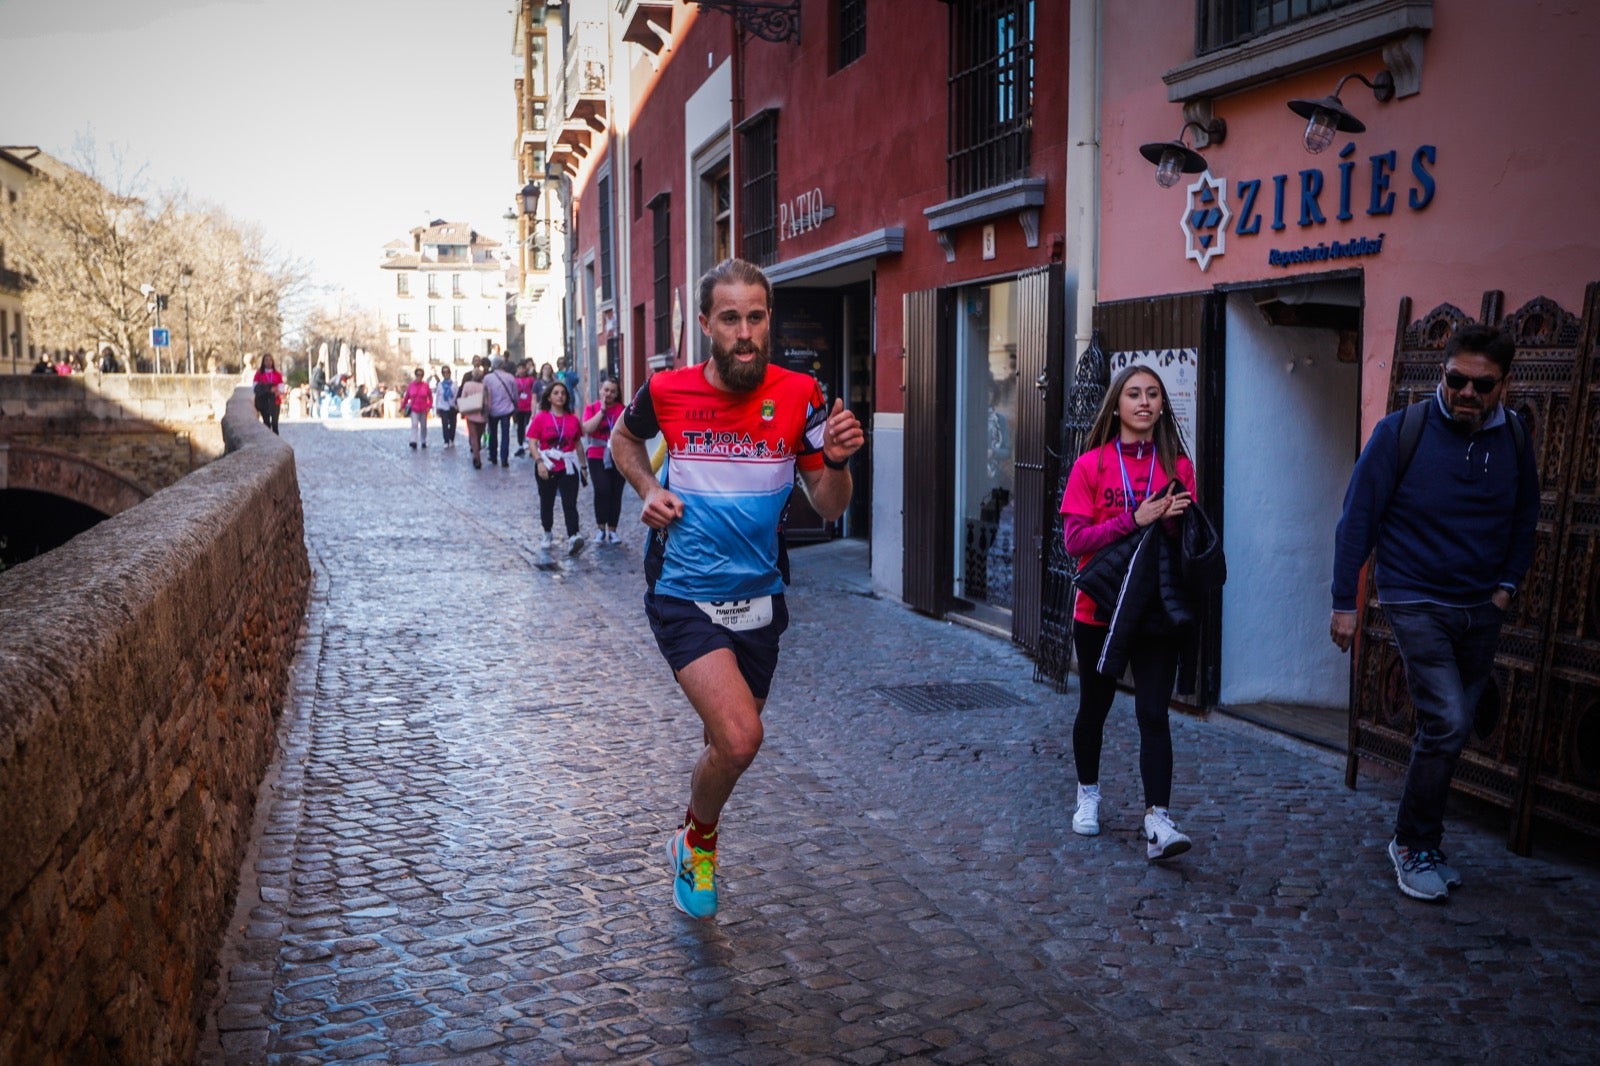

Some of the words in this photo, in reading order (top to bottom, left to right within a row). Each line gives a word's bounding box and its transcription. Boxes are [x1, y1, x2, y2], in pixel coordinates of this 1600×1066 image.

[1235, 142, 1436, 235] ZIRÍES
[780, 187, 823, 242] PATIO
[1269, 243, 1329, 267] Repostería
[1329, 233, 1385, 258] Andalusí
[1104, 488, 1114, 507] 9
